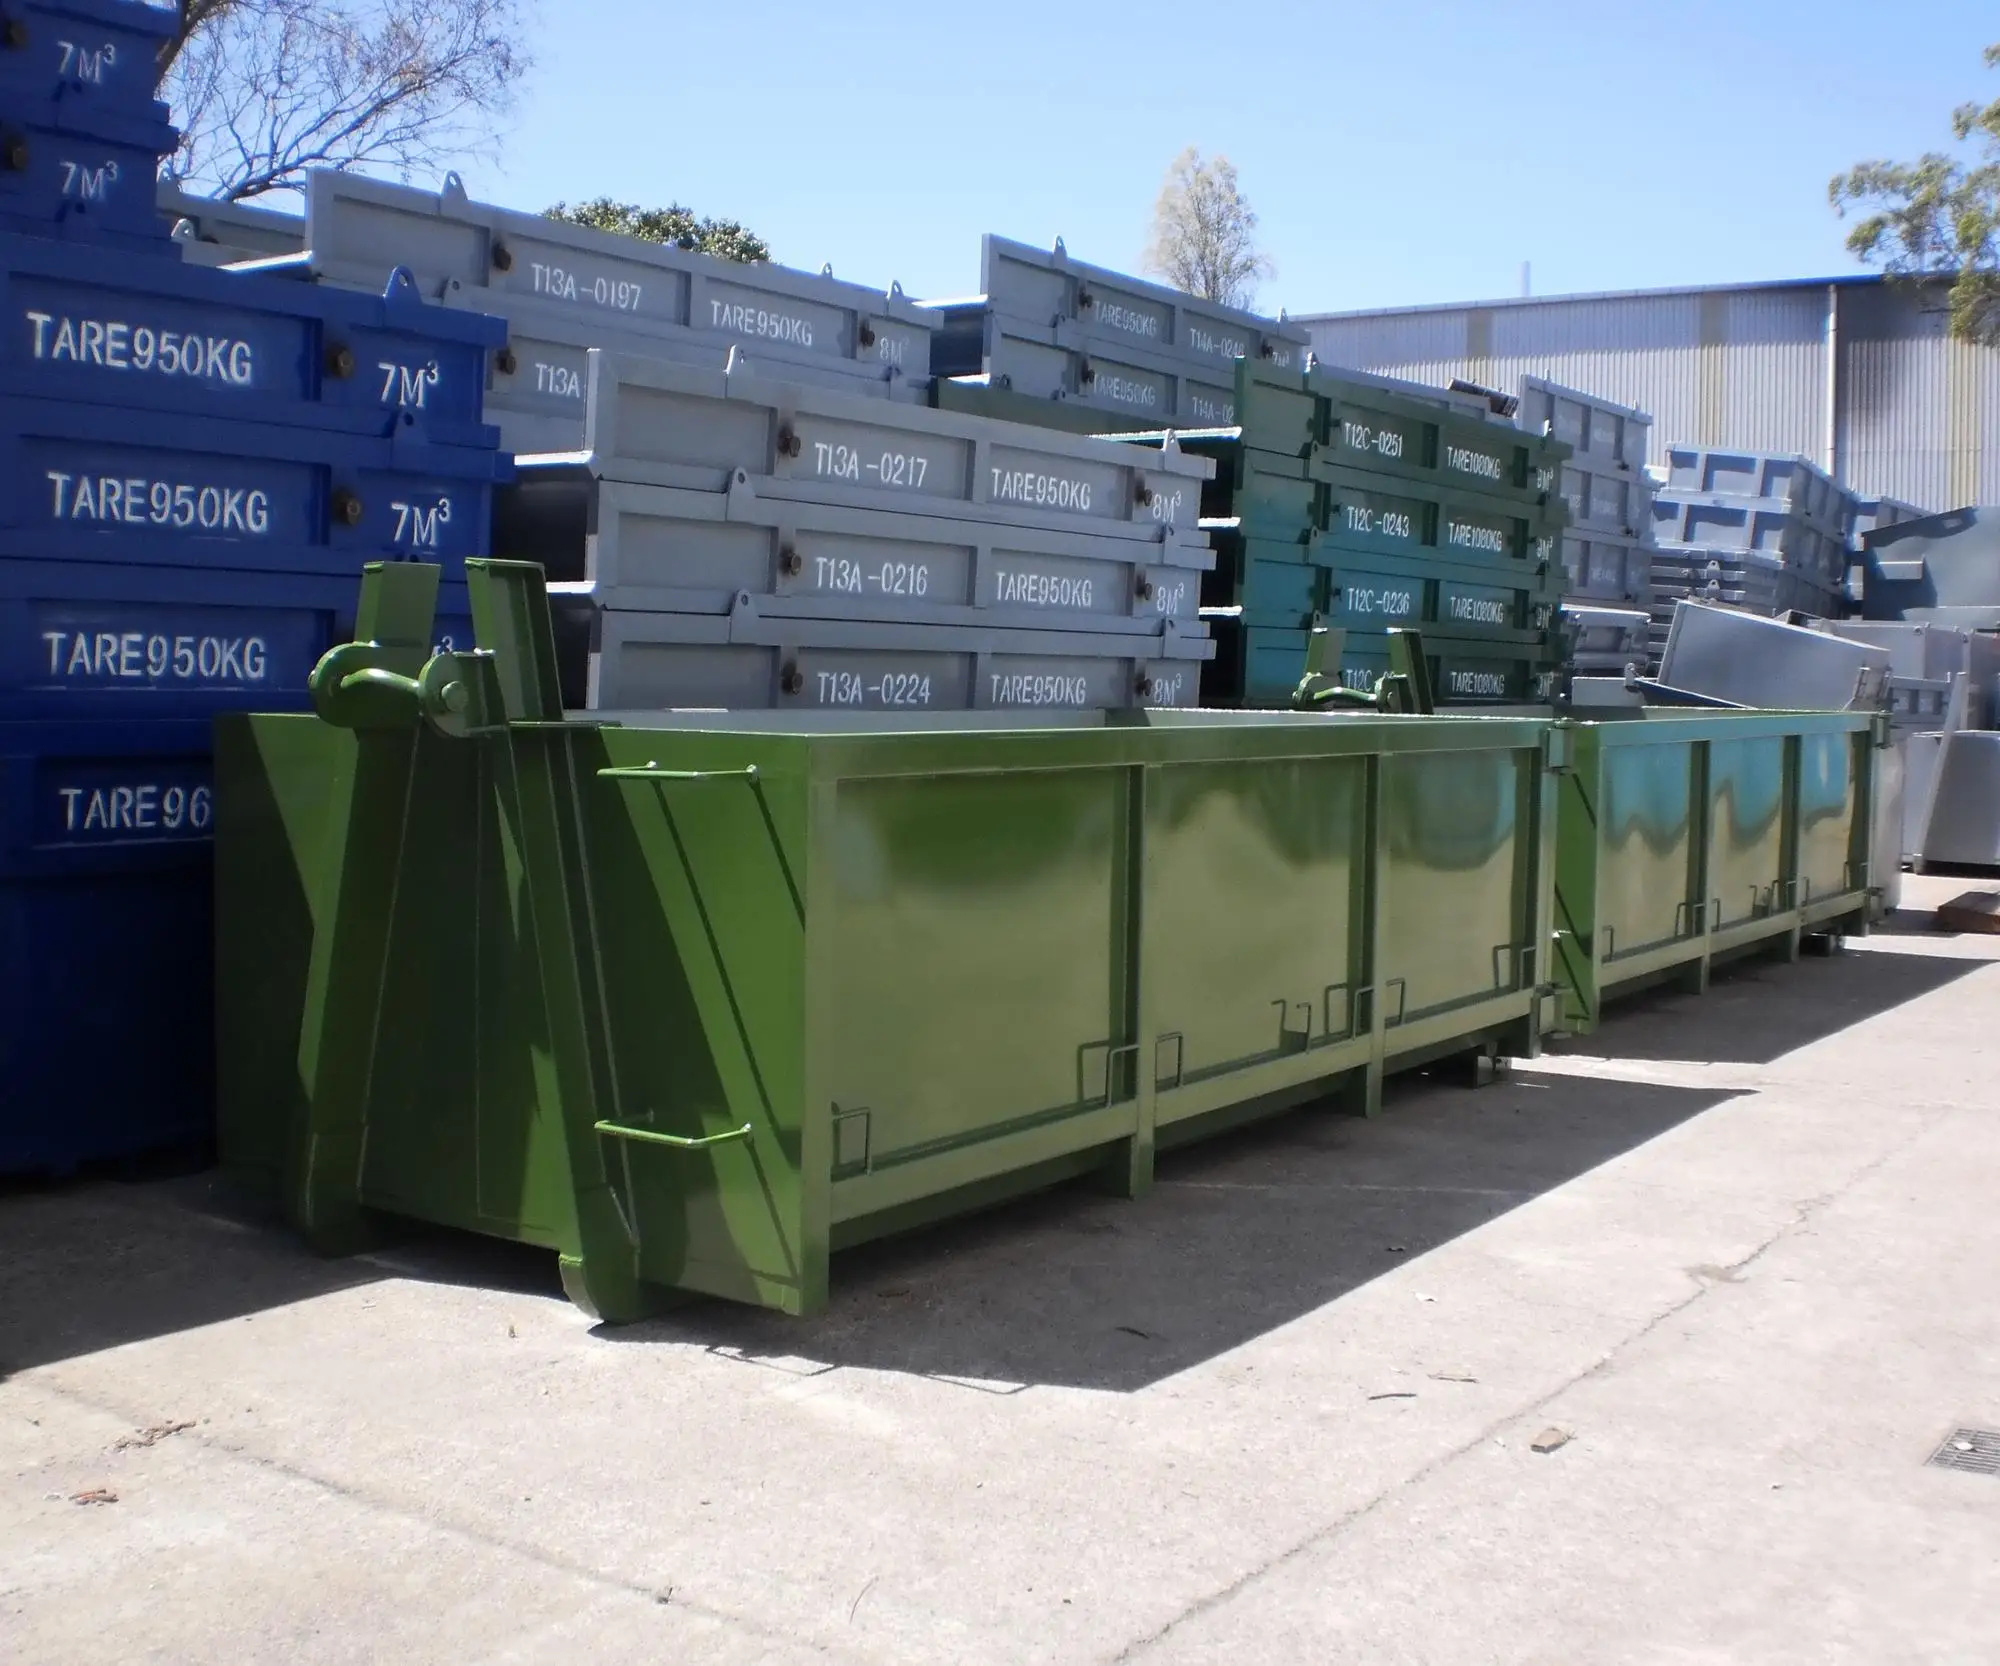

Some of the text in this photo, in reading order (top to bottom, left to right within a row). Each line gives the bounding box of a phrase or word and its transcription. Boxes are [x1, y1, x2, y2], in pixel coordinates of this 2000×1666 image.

[711, 300, 812, 346] TARE950KG
[27, 311, 252, 384] TARE950KG
[46, 472, 268, 533] TARE950KG
[992, 468, 1090, 510] TARE950KG
[996, 573, 1092, 608] TARE950KG
[43, 632, 266, 679] TARE950KG
[992, 675, 1086, 705] TARE950KG
